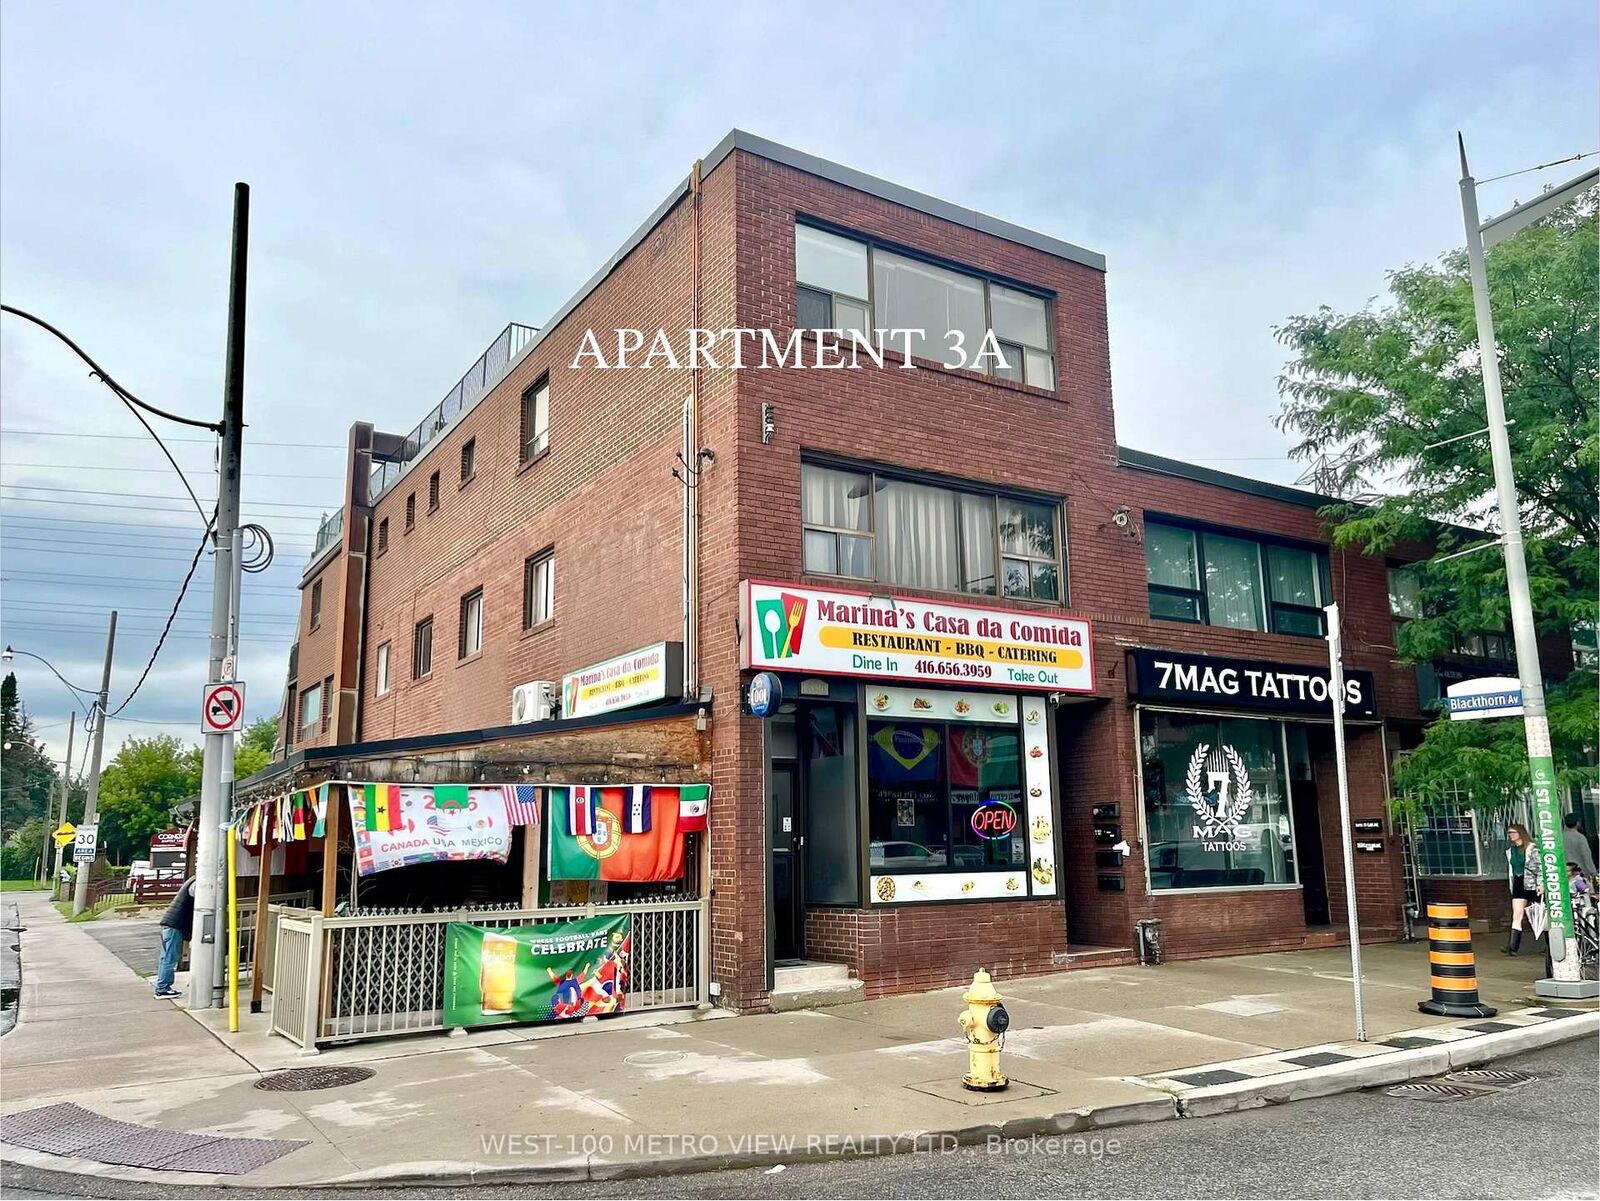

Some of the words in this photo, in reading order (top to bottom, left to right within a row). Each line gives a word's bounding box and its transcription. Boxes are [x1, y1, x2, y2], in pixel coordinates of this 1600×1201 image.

[816, 599, 916, 630] Marina's
[922, 611, 970, 636] Casa
[976, 617, 1003, 639] da
[1010, 620, 1082, 647] Comida
[852, 632, 942, 653] RESTAURANT
[956, 642, 985, 658] BBQ
[997, 646, 1057, 664] CATERING
[852, 653, 882, 671] Dine
[886, 657, 898, 672] In
[914, 659, 992, 679] 416.656.3959
[1007, 667, 1035, 683] Take
[1037, 670, 1059, 684] Out
[1154, 660, 1240, 695] 7MAG
[1450, 694, 1506, 710] Blackthorn
[1508, 695, 1518, 704] Av
[974, 810, 1013, 830] OPEN
[1192, 825, 1253, 839] MAG
[1538, 810, 1556, 850] CLAIR
[78, 834, 95, 845] 30
[380, 838, 430, 853] CANADA
[433, 837, 456, 848] USA
[461, 836, 503, 848] MEXICO
[1202, 841, 1247, 852] TATTOOS
[1543, 853, 1564, 919] GARDENS
[531, 937, 608, 955] CELEBRATE
[555, 933, 591, 942] FOOTBALL
